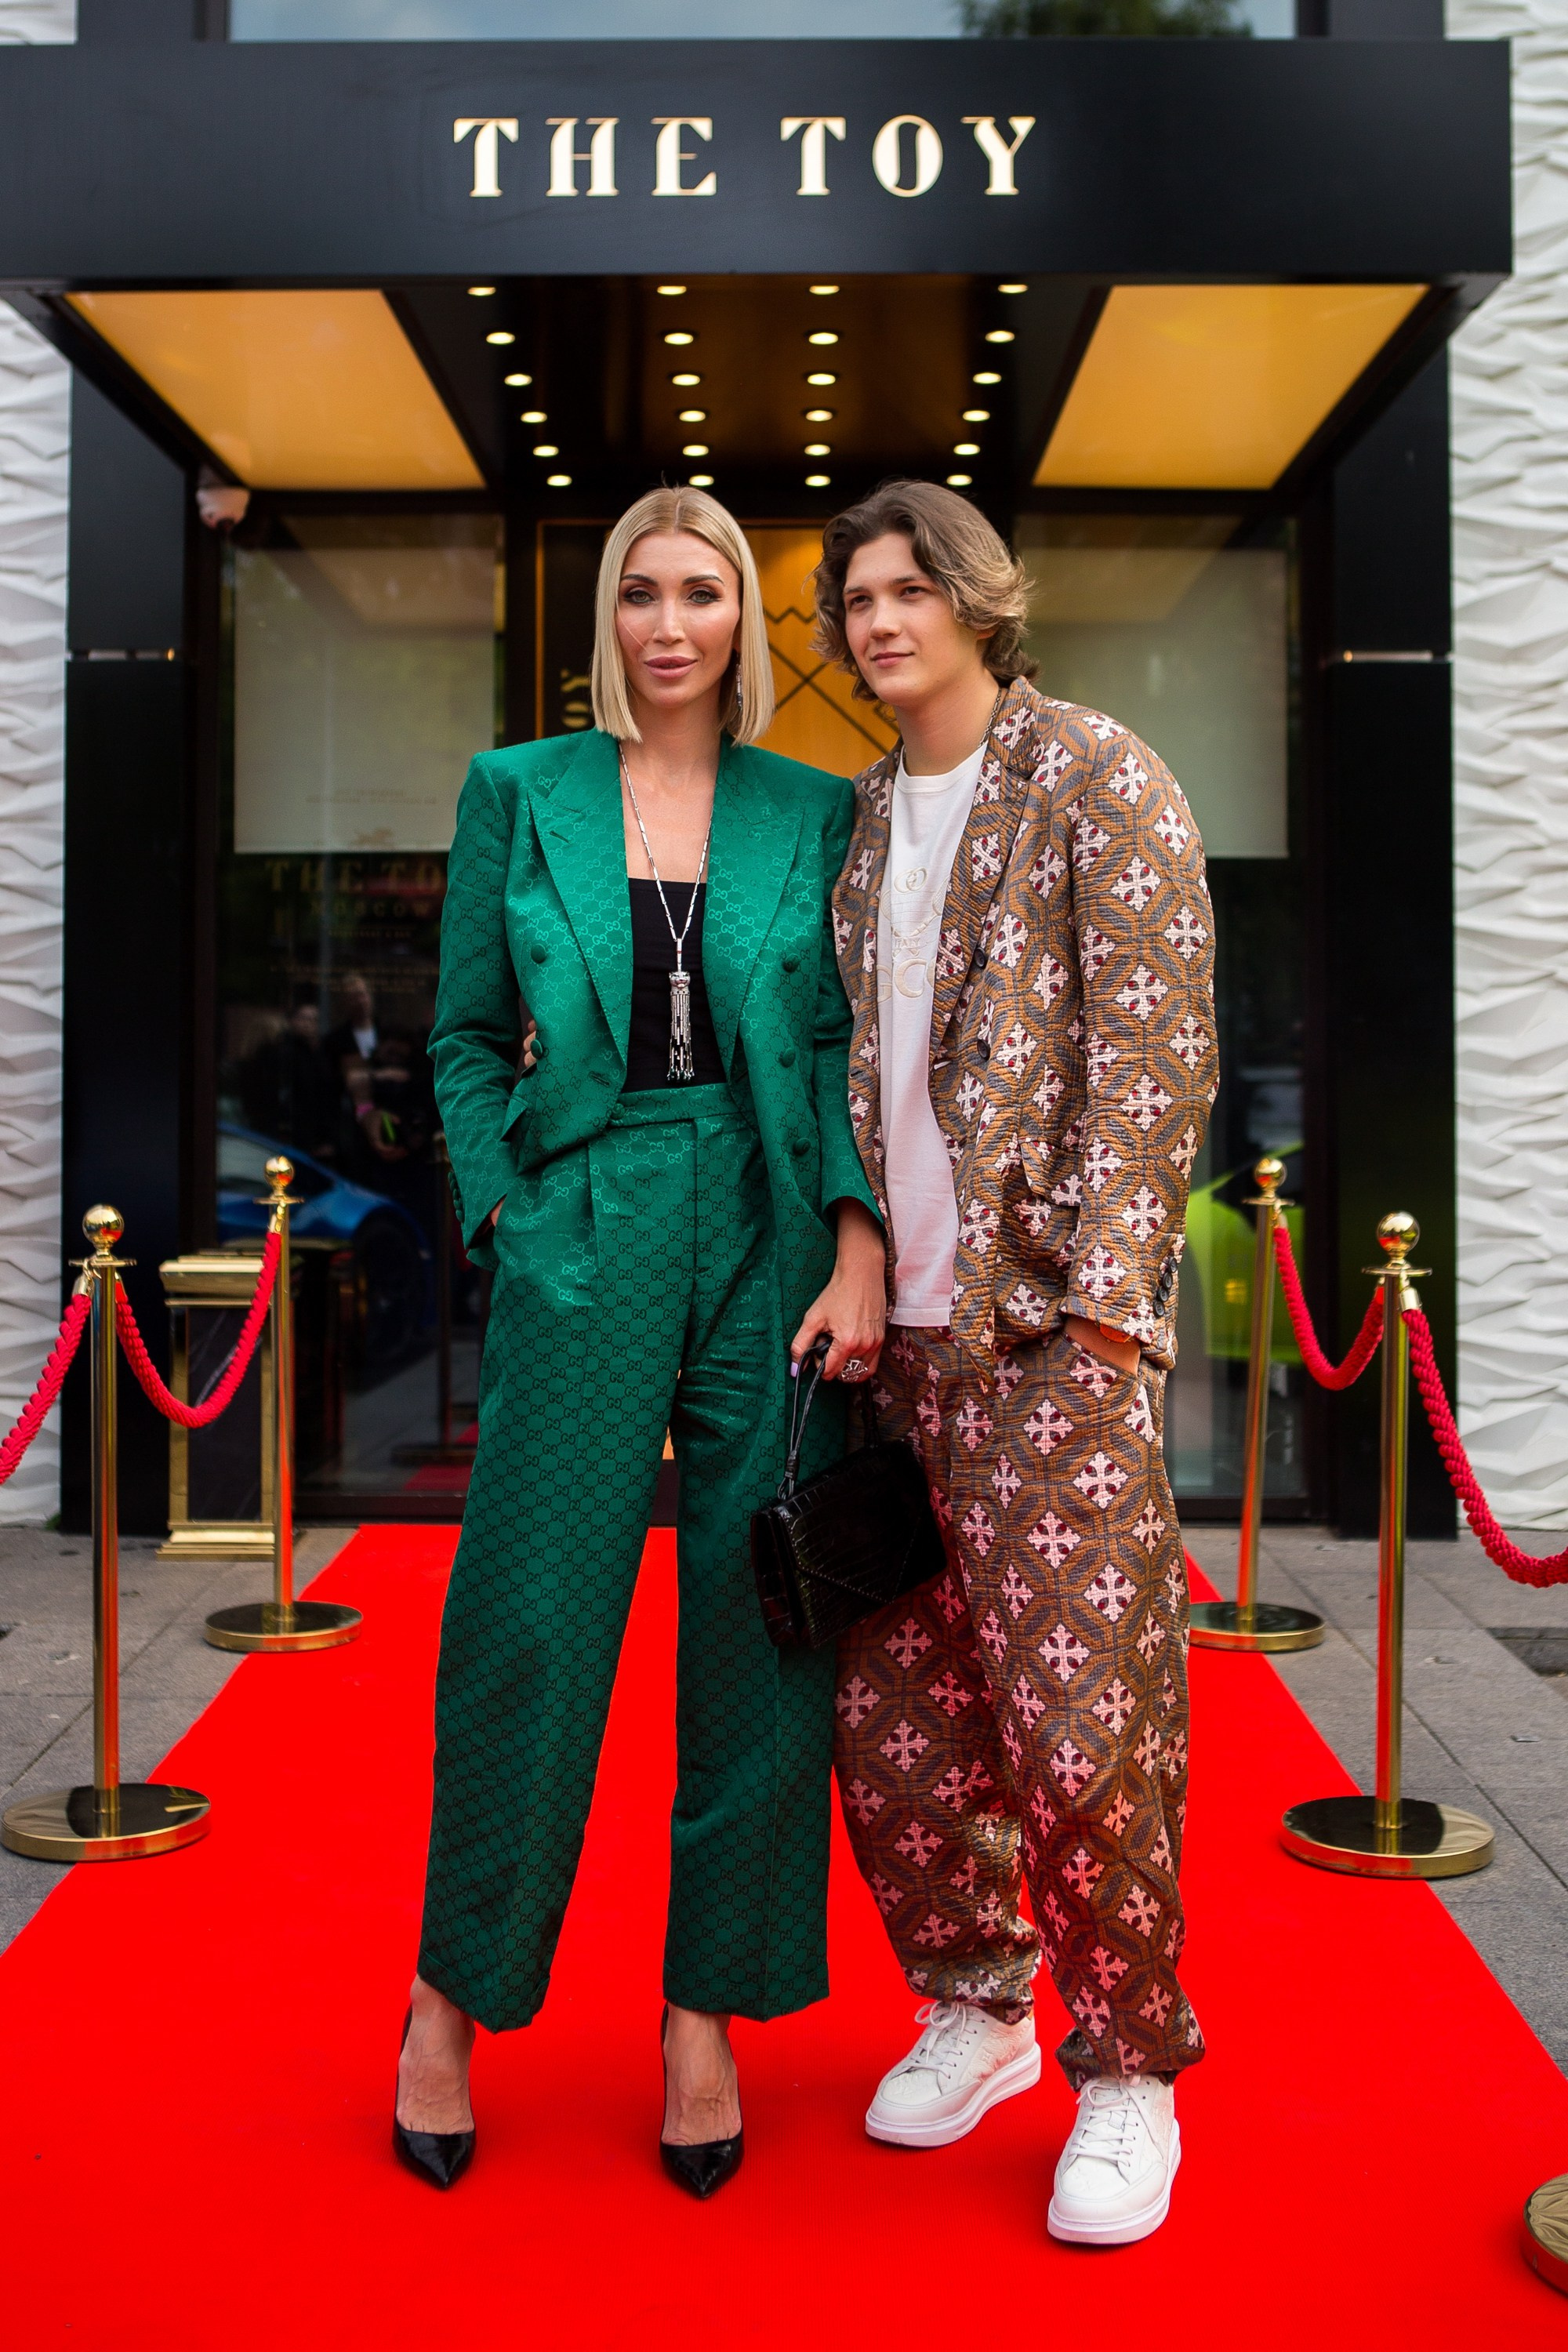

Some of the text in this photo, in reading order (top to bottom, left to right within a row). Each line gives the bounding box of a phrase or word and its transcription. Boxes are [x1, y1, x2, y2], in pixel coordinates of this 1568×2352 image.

[453, 114, 1036, 198] THE TOY
[265, 860, 445, 892] THE TO
